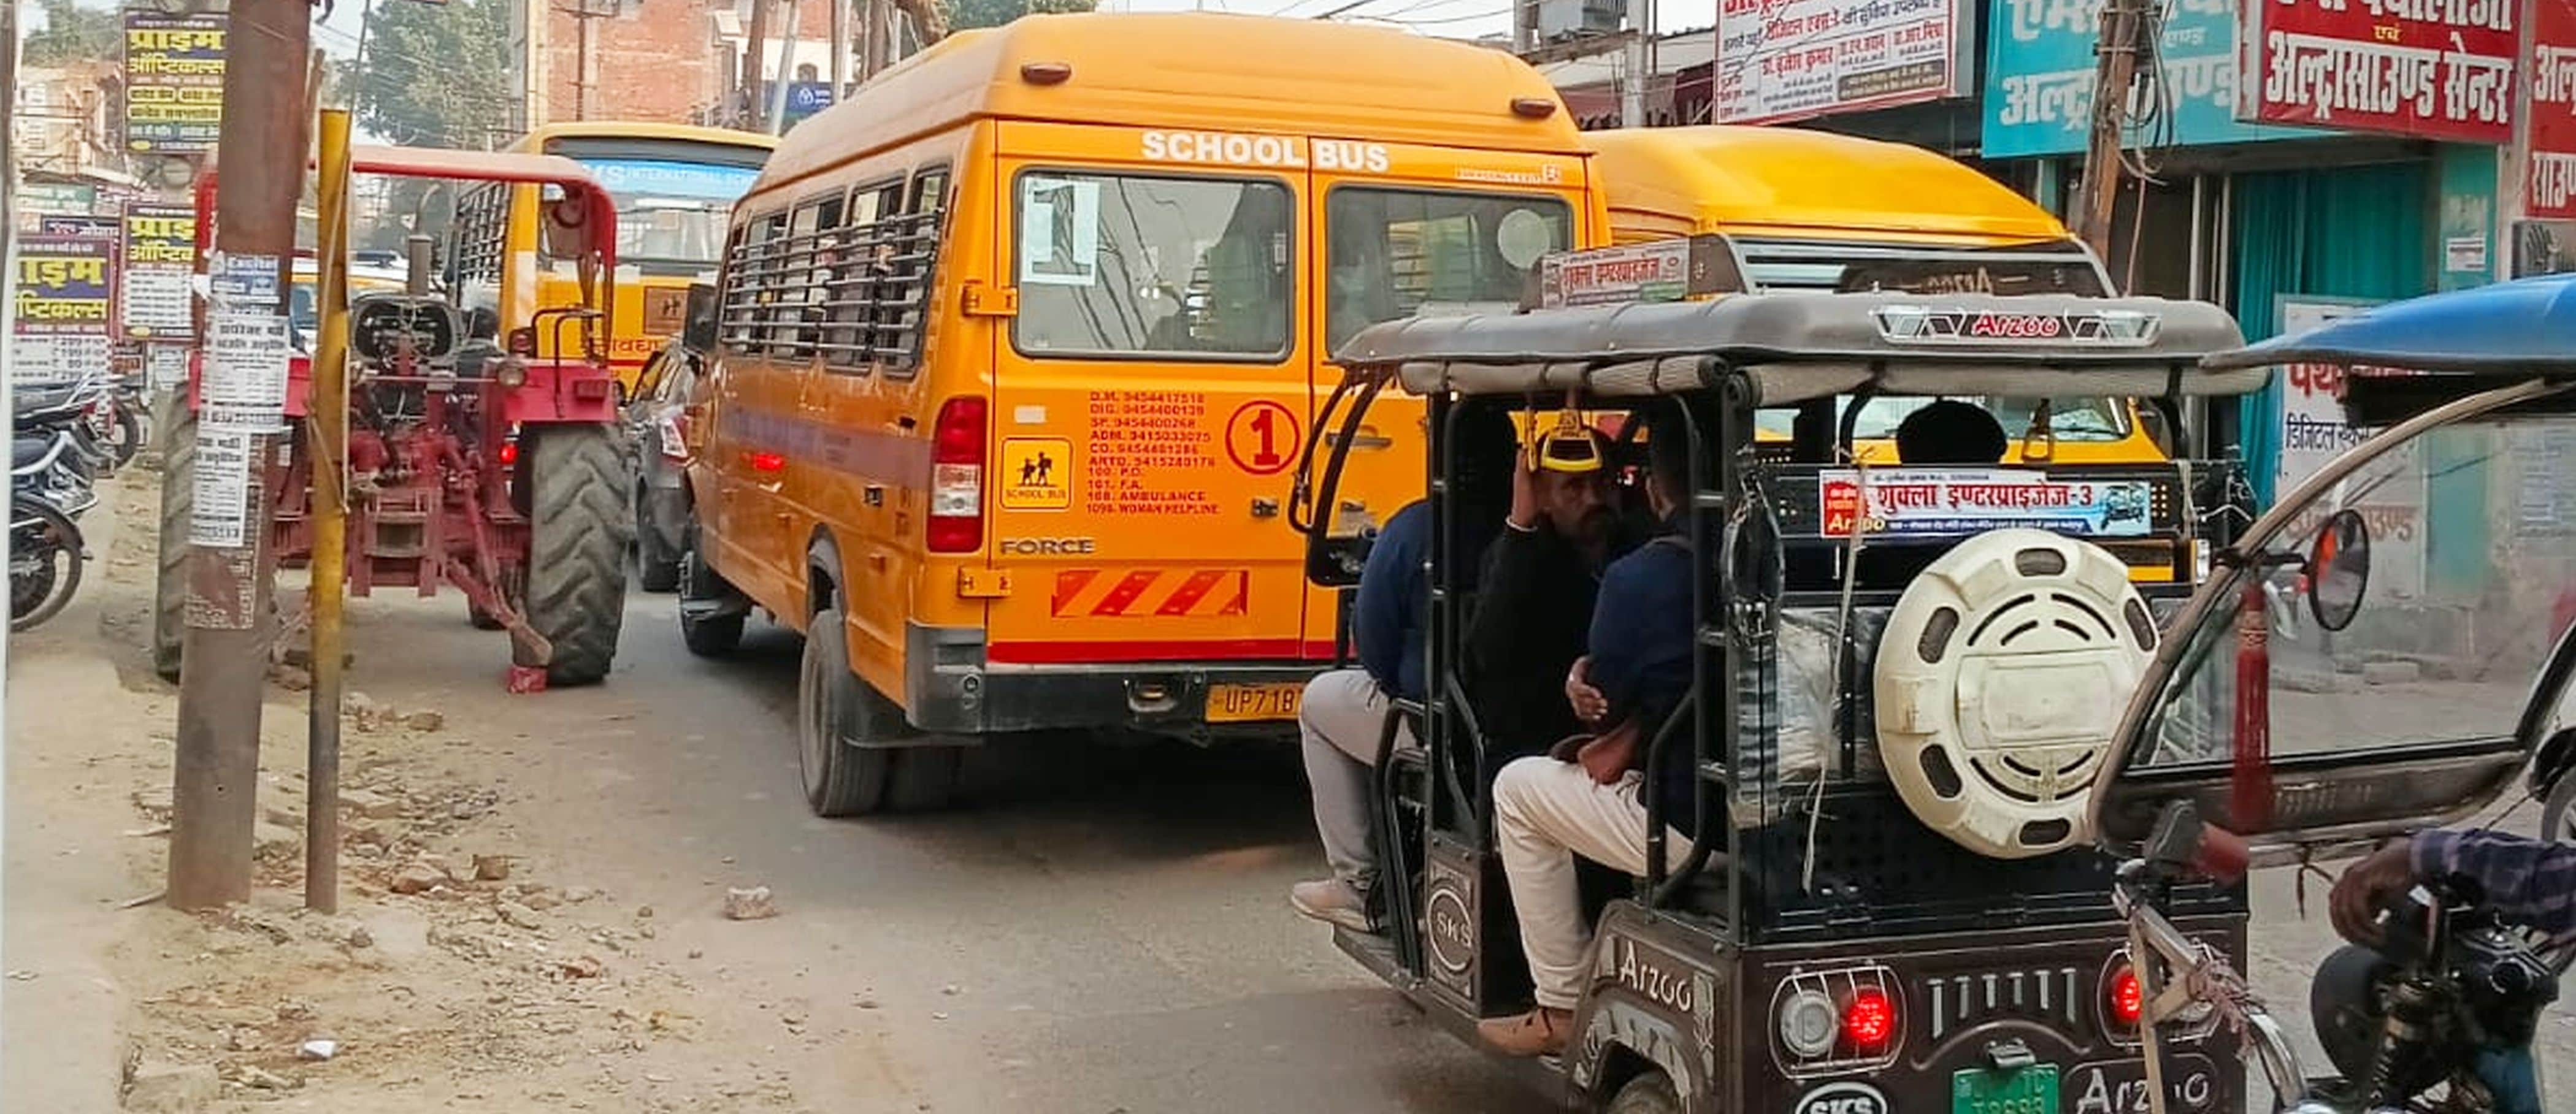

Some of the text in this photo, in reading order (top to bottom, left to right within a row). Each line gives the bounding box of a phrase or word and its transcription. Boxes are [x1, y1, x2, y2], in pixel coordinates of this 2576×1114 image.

[128, 30, 226, 52] प्राइम
[2373, 21, 2403, 43] एवं
[128, 52, 226, 74] ऑप्टिकल्स
[2266, 31, 2512, 124] अल्ट्रासाउण्ड सेन्टर
[1141, 131, 1389, 172] SCHOOL BUS
[128, 216, 195, 238] प्राइ
[1032, 184, 1092, 275] 1
[17, 258, 108, 289] ाइम
[16, 289, 108, 319] प्टिकल्स
[1971, 312, 2060, 337] Arzoo
[1250, 408, 1281, 465] 1
[2286, 413, 2336, 451] डिजिटल
[1120, 492, 1206, 502] AMBULANCE
[1878, 484, 1938, 514] शुक्ला
[1830, 513, 1887, 533] Aroo
[1000, 538, 1096, 555] FORCE
[1436, 911, 1473, 948] SKS
[1620, 940, 1692, 1012] Arzoo
[2077, 1067, 2208, 1114] Arzo
